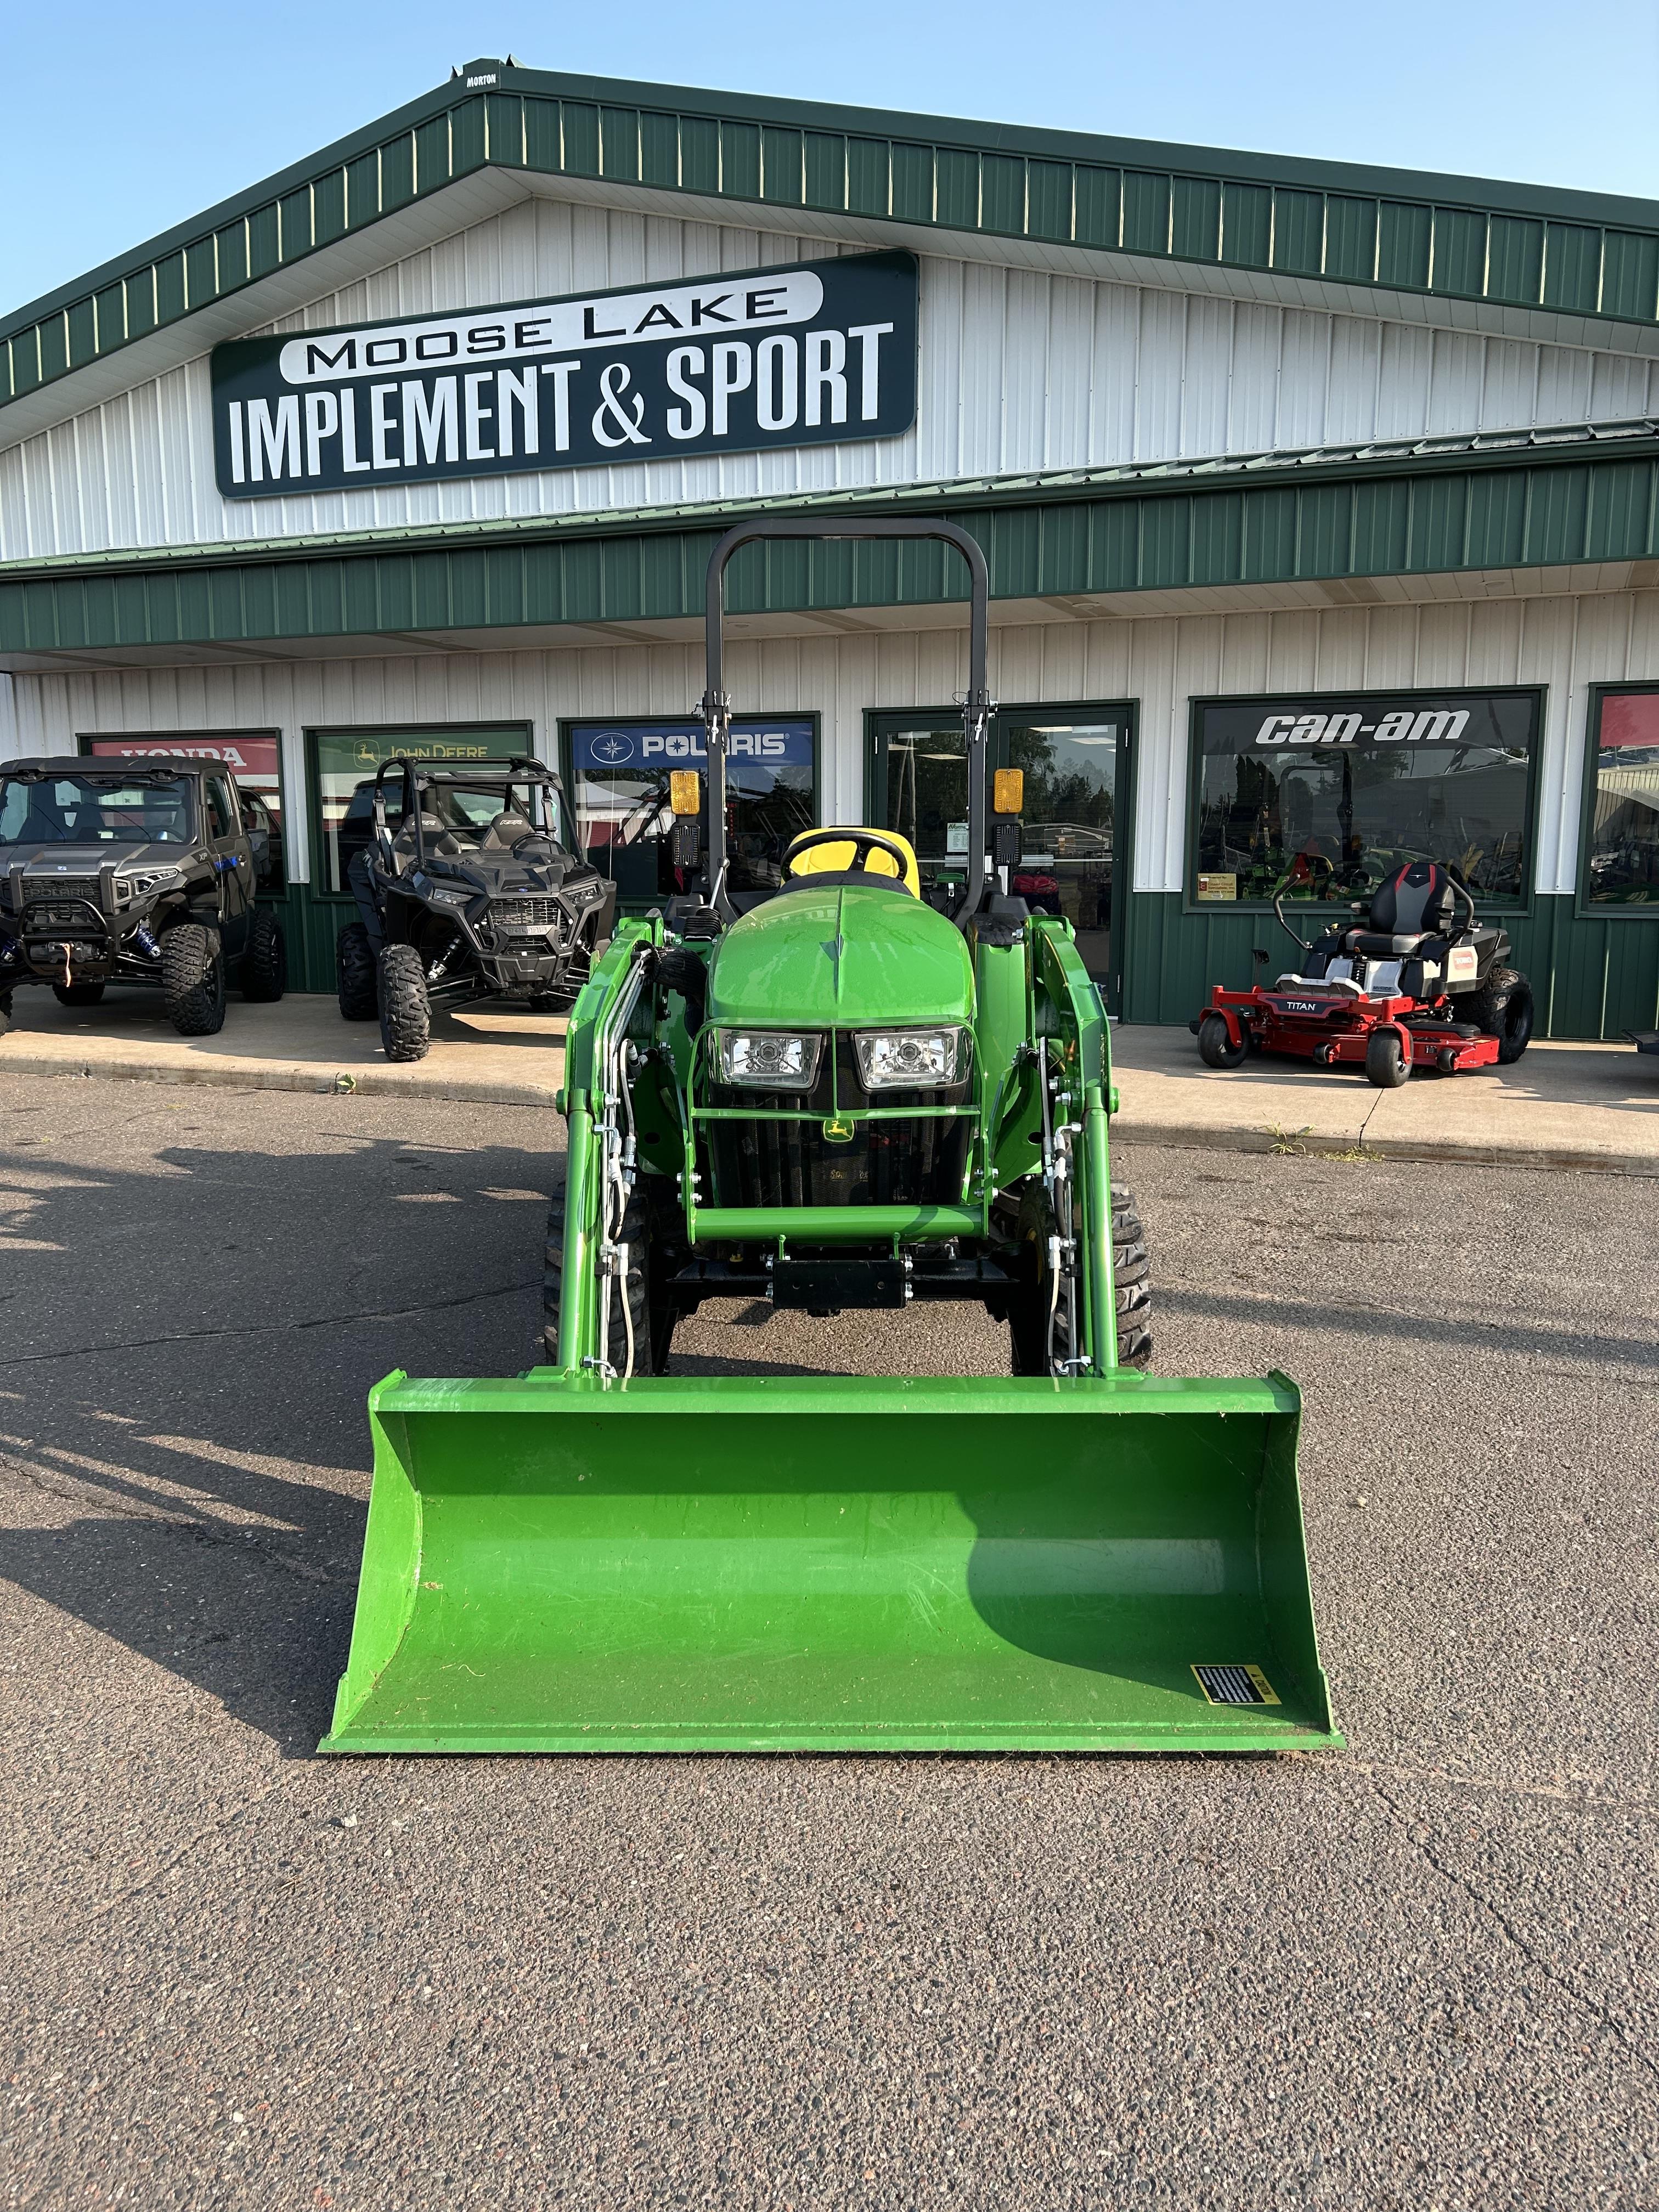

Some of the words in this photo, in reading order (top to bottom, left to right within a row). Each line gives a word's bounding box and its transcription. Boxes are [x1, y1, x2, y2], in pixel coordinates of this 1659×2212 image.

[467, 74, 496, 88] MORTON
[307, 318, 552, 375] MOOSE
[584, 287, 788, 340] LAKE
[229, 360, 581, 483] IMPLEMENT
[591, 363, 653, 447] &
[666, 322, 894, 439] SPORT
[1255, 710, 1470, 744] can-am
[386, 746, 430, 759] JOHN
[433, 744, 488, 758] DEERE
[642, 733, 790, 757] POLRIS®
[199, 852, 208, 862] XP
[1286, 1001, 1316, 1011] TITAN
